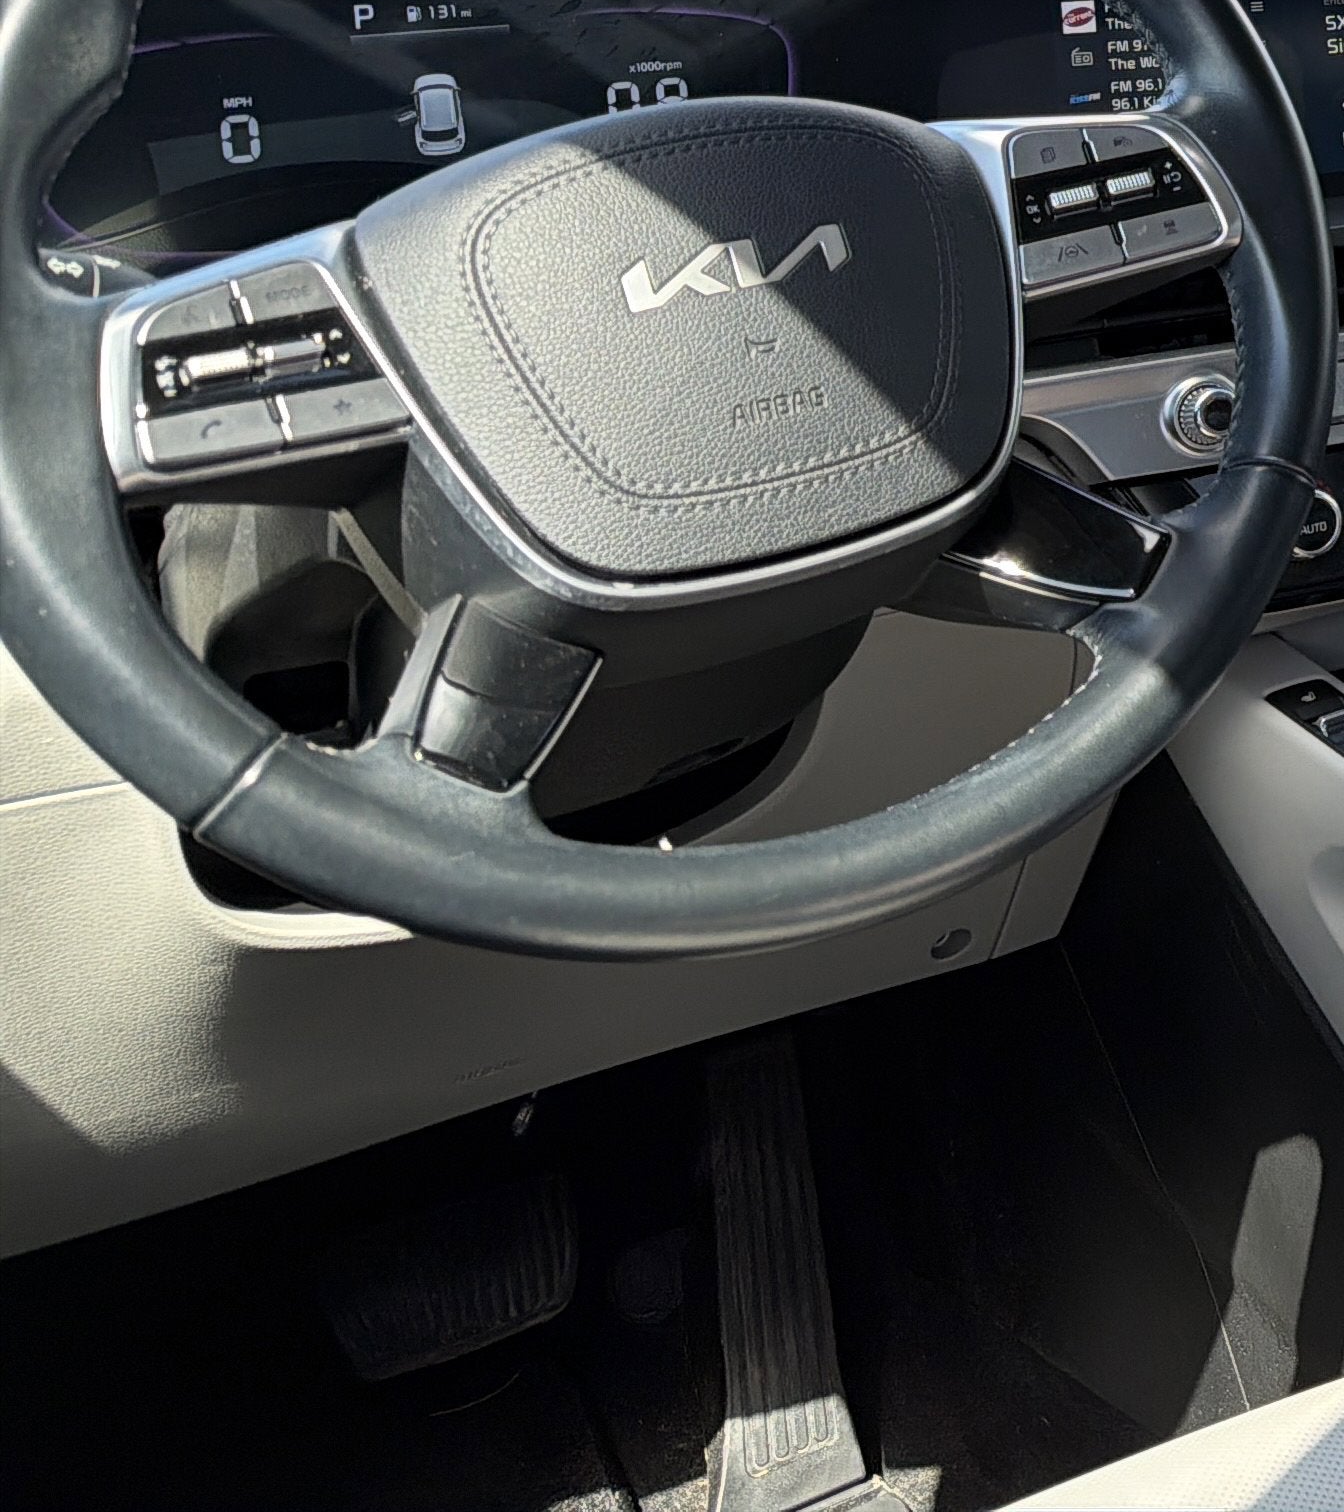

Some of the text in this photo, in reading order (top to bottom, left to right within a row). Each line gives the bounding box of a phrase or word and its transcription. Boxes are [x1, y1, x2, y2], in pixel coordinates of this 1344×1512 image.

[353, 4, 473, 30] P 131 mi
[1108, 41, 1129, 53] FM
[629, 61, 683, 73] x1000rpm
[1109, 58, 1136, 70] The
[1111, 78, 1162, 93] FM 96.1
[222, 96, 253, 109] MPH
[1112, 97, 1139, 111] 96.1
[220, 114, 262, 164] 0
[621, 223, 852, 313] KIA
[732, 386, 831, 429] AIRBAG
[1300, 520, 1328, 536] AUTO
